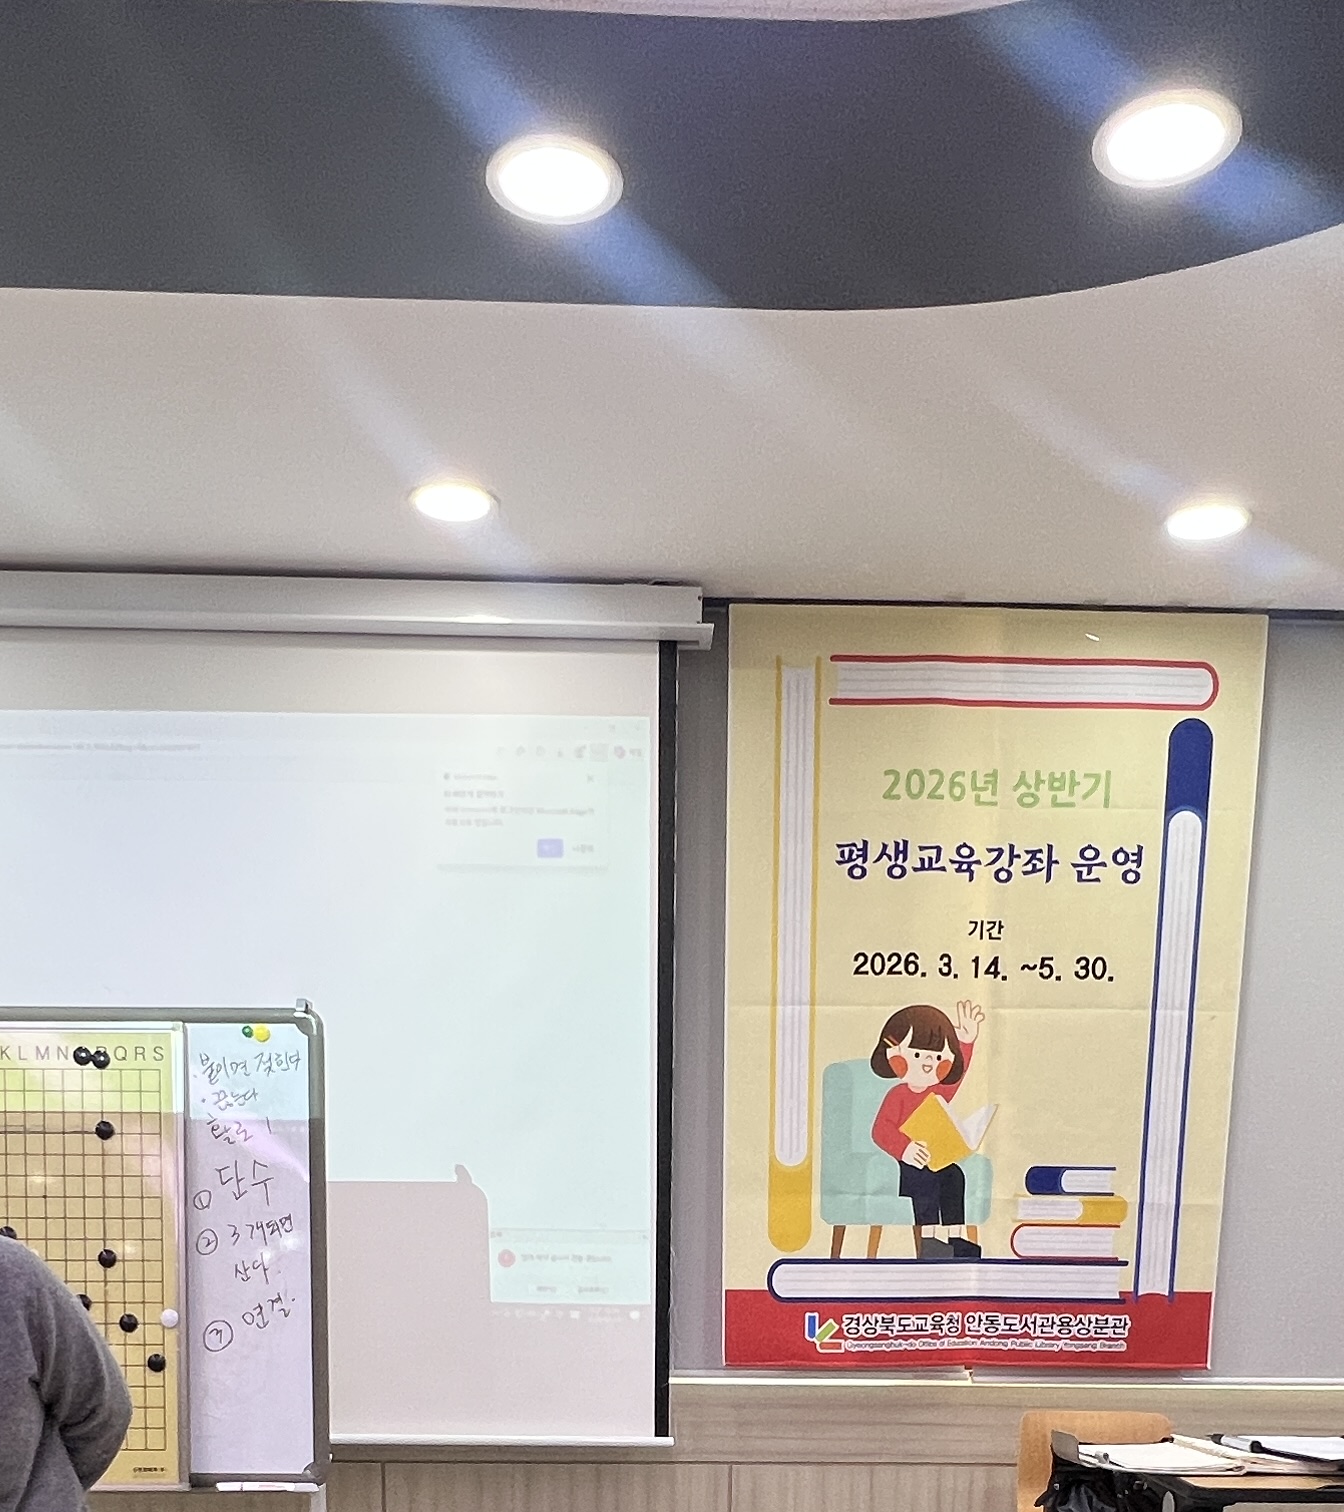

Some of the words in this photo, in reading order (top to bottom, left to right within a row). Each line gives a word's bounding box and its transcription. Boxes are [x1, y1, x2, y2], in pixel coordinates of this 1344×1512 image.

[881, 768, 999, 807] 2026년
[1012, 769, 1112, 809] 상반기
[834, 838, 1061, 885] 평생교육강좌
[1069, 843, 1144, 885] 운영
[967, 919, 1005, 941] 기간
[852, 951, 928, 979] 2026.
[937, 952, 959, 980] 3.
[970, 955, 1008, 982] 14.
[1019, 956, 1062, 982] ~5.
[1073, 956, 1115, 983] 30.
[0, 1045, 12, 1061] K
[18, 1046, 28, 1061] L
[35, 1045, 50, 1060] M
[57, 1046, 68, 1060] N
[114, 1046, 127, 1061] Q
[134, 1046, 146, 1061] R
[153, 1046, 164, 1061] S
[214, 1159, 275, 1207] 단수
[844, 1315, 960, 1335] 경상북도교육청
[966, 1315, 1129, 1336] 안동도서관용상분관
